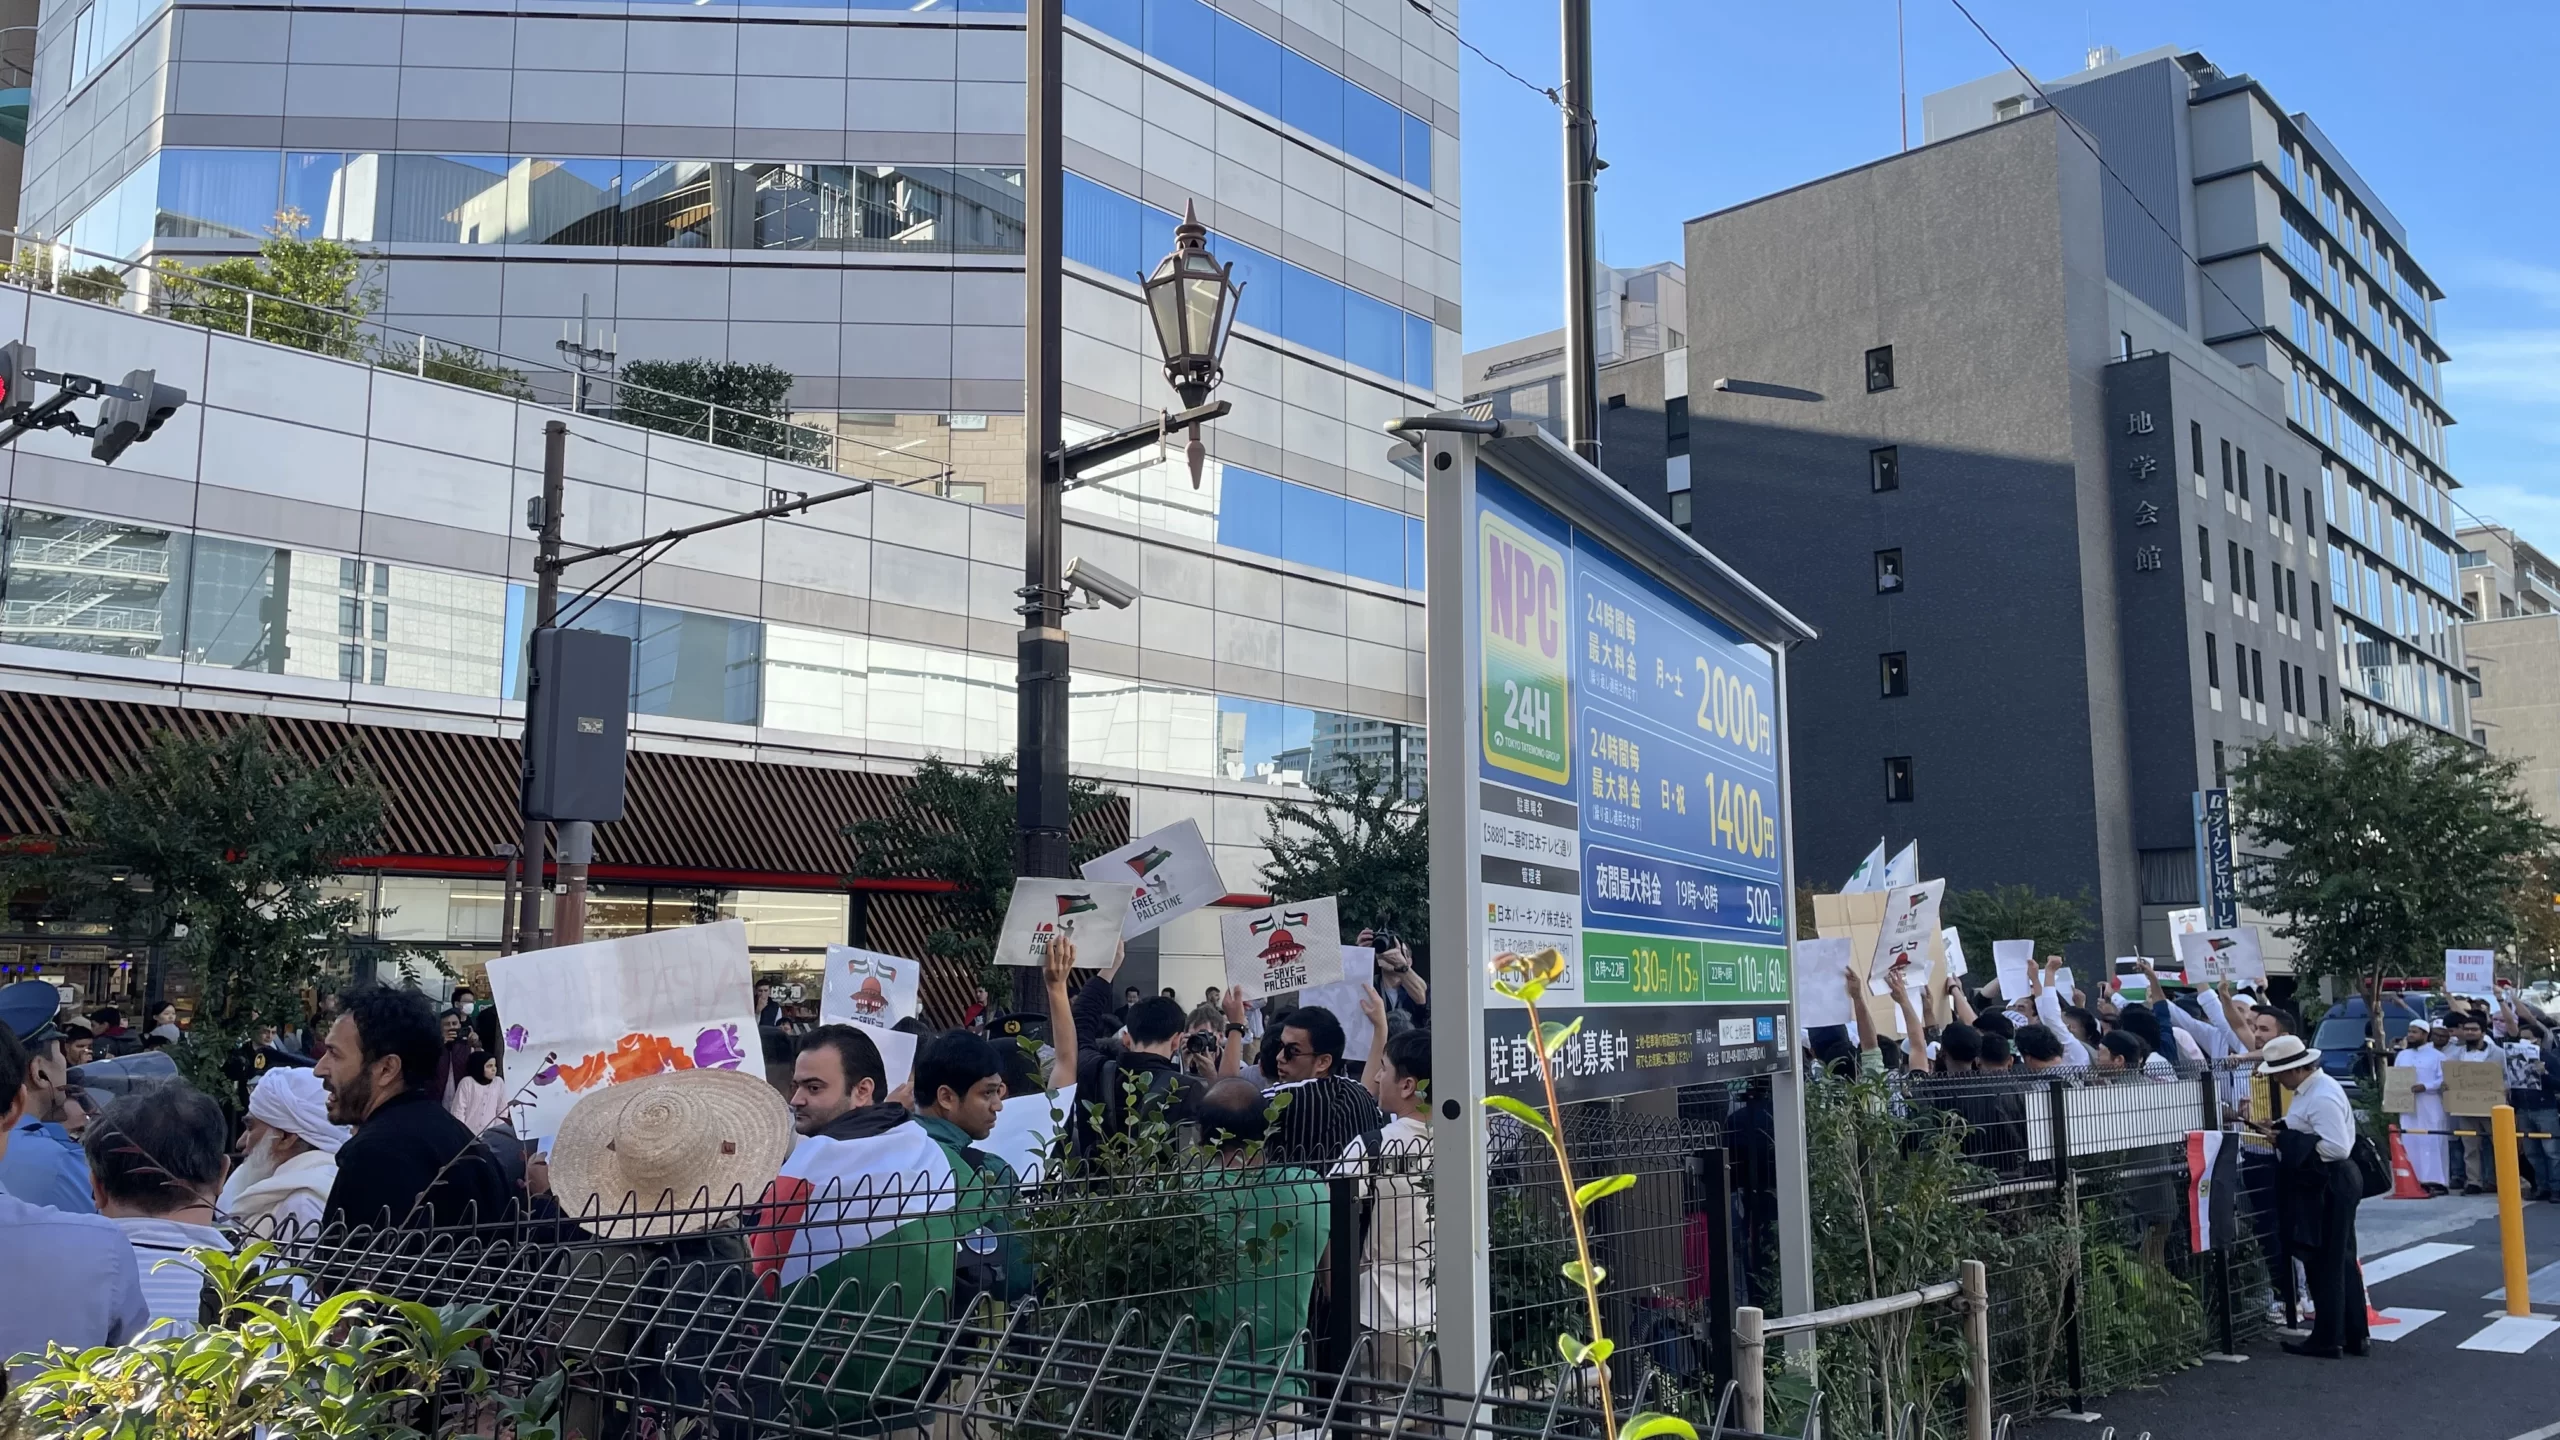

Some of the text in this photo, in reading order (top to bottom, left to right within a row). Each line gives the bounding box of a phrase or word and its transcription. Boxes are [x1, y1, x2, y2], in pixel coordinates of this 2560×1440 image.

[2127, 410, 2162, 571] 地学会館
[1489, 533, 1558, 659] NPC
[1587, 592, 1636, 646] 24時間毎
[1588, 630, 1637, 681] 最大料金
[1503, 679, 1551, 741] 24H
[1695, 655, 1771, 756] 2000円
[1504, 736, 1522, 751] TOKYO
[1545, 749, 1561, 763] GROUP
[1590, 727, 1640, 773] 24時間毎
[1592, 766, 1641, 809] 最大料金
[1705, 771, 1775, 859] 1400円
[1521, 867, 1542, 885] 管理者
[1596, 862, 1662, 906] 夜間最大料金
[1746, 885, 1778, 927] 500円
[1131, 894, 1155, 911] FREE
[1136, 894, 1183, 922] PALESTINE
[1497, 904, 1573, 929] 日本パーキング株式会社
[1264, 974, 1308, 992] PALESTINE
[1273, 965, 1296, 980] SAVE
